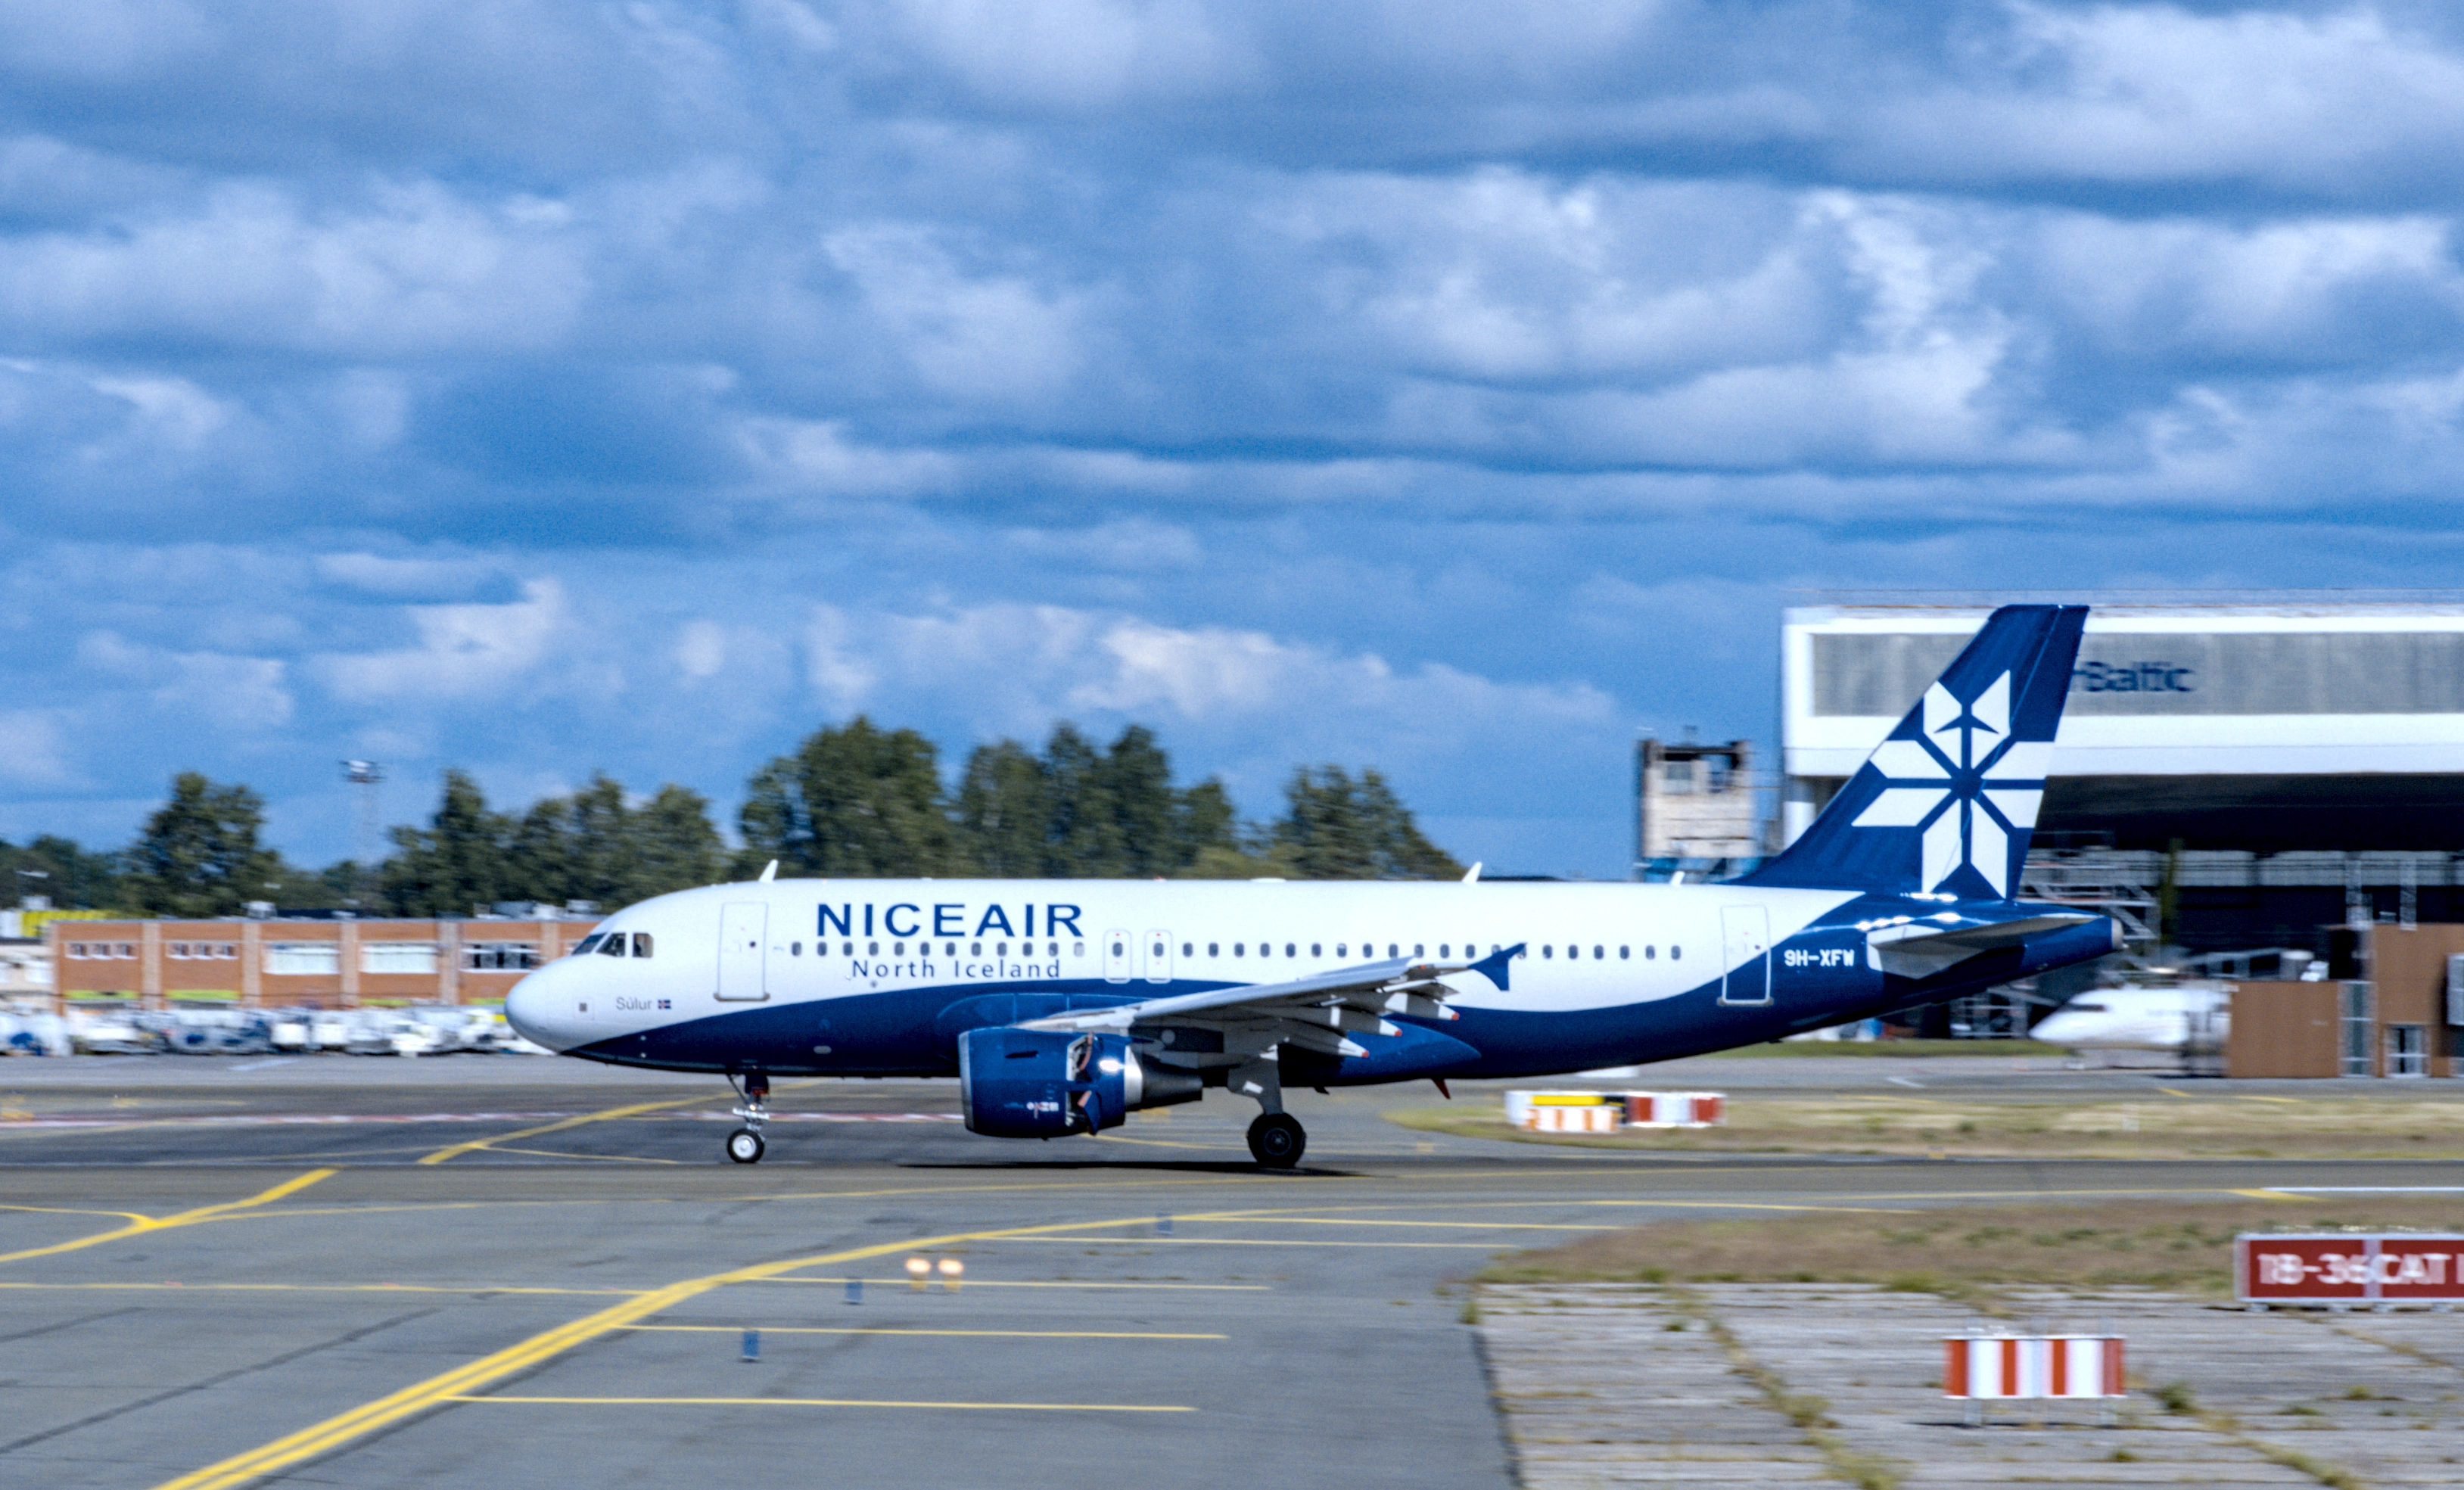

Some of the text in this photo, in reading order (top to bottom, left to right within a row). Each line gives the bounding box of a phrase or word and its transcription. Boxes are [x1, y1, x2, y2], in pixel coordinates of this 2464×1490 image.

[817, 904, 1084, 937] NICEAIR
[1784, 949, 1855, 966] 9H-XFW
[852, 959, 1059, 978] North Iceland
